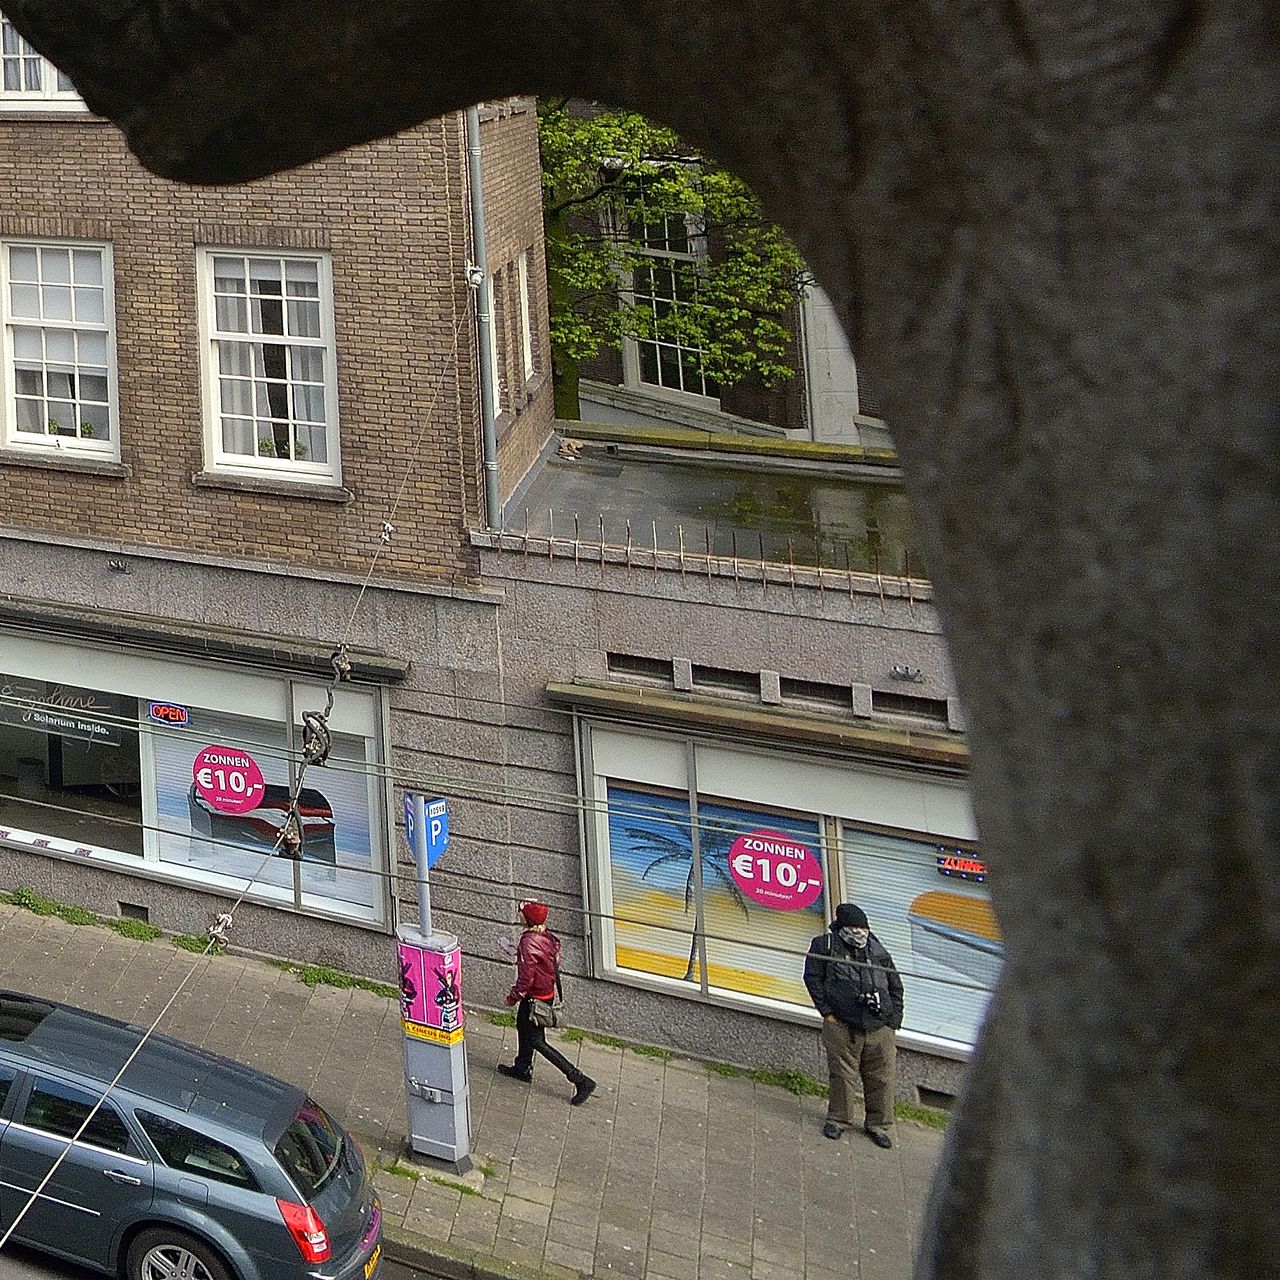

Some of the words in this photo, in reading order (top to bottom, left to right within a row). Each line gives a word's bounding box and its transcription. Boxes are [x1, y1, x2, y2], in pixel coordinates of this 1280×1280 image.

[33, 713, 76, 729] Solarium
[151, 705, 186, 721] OPEN
[203, 753, 250, 768] ZONNEN
[431, 819, 442, 846] P
[743, 838, 806, 861] ZONNEN
